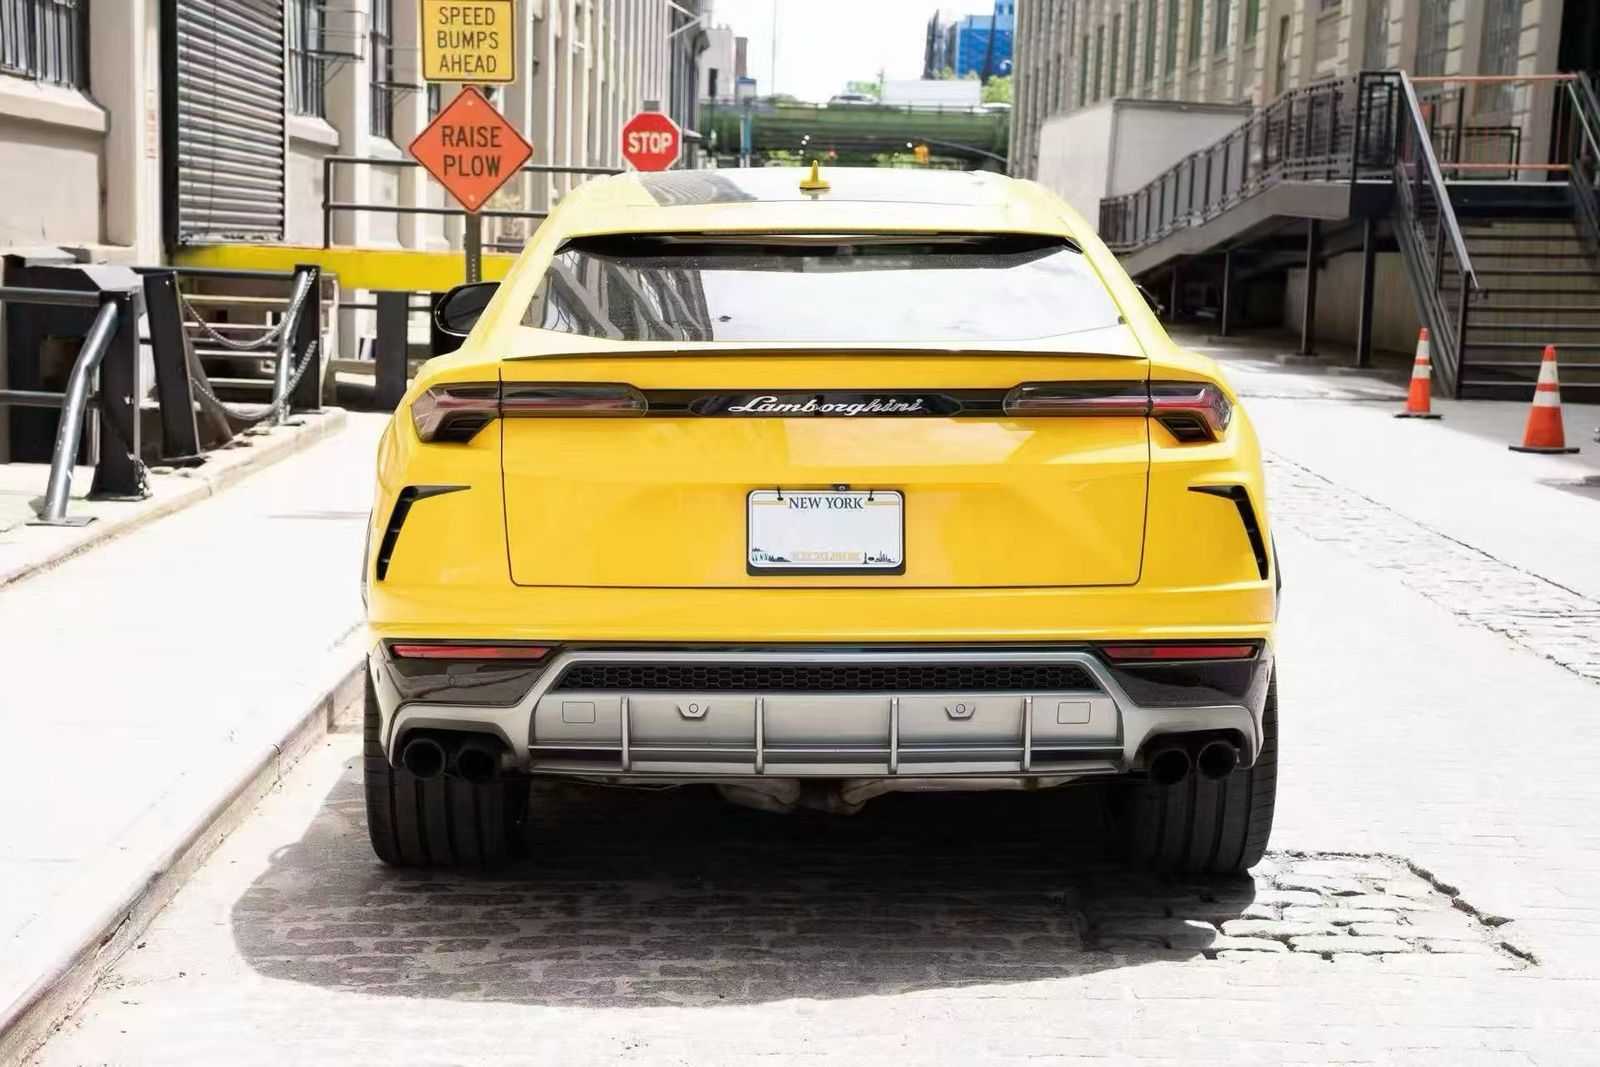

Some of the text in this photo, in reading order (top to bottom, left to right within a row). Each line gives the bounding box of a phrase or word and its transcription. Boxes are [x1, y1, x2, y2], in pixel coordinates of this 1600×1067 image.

[439, 7, 495, 26] SPEED
[437, 31, 499, 50] BUMPS
[439, 55, 497, 73] AHEAD
[441, 126, 502, 148] RAISE
[628, 131, 673, 154] STOP
[443, 155, 501, 177] PLOW
[728, 395, 923, 416] Lamborghini
[789, 497, 864, 509] NEW YORK
